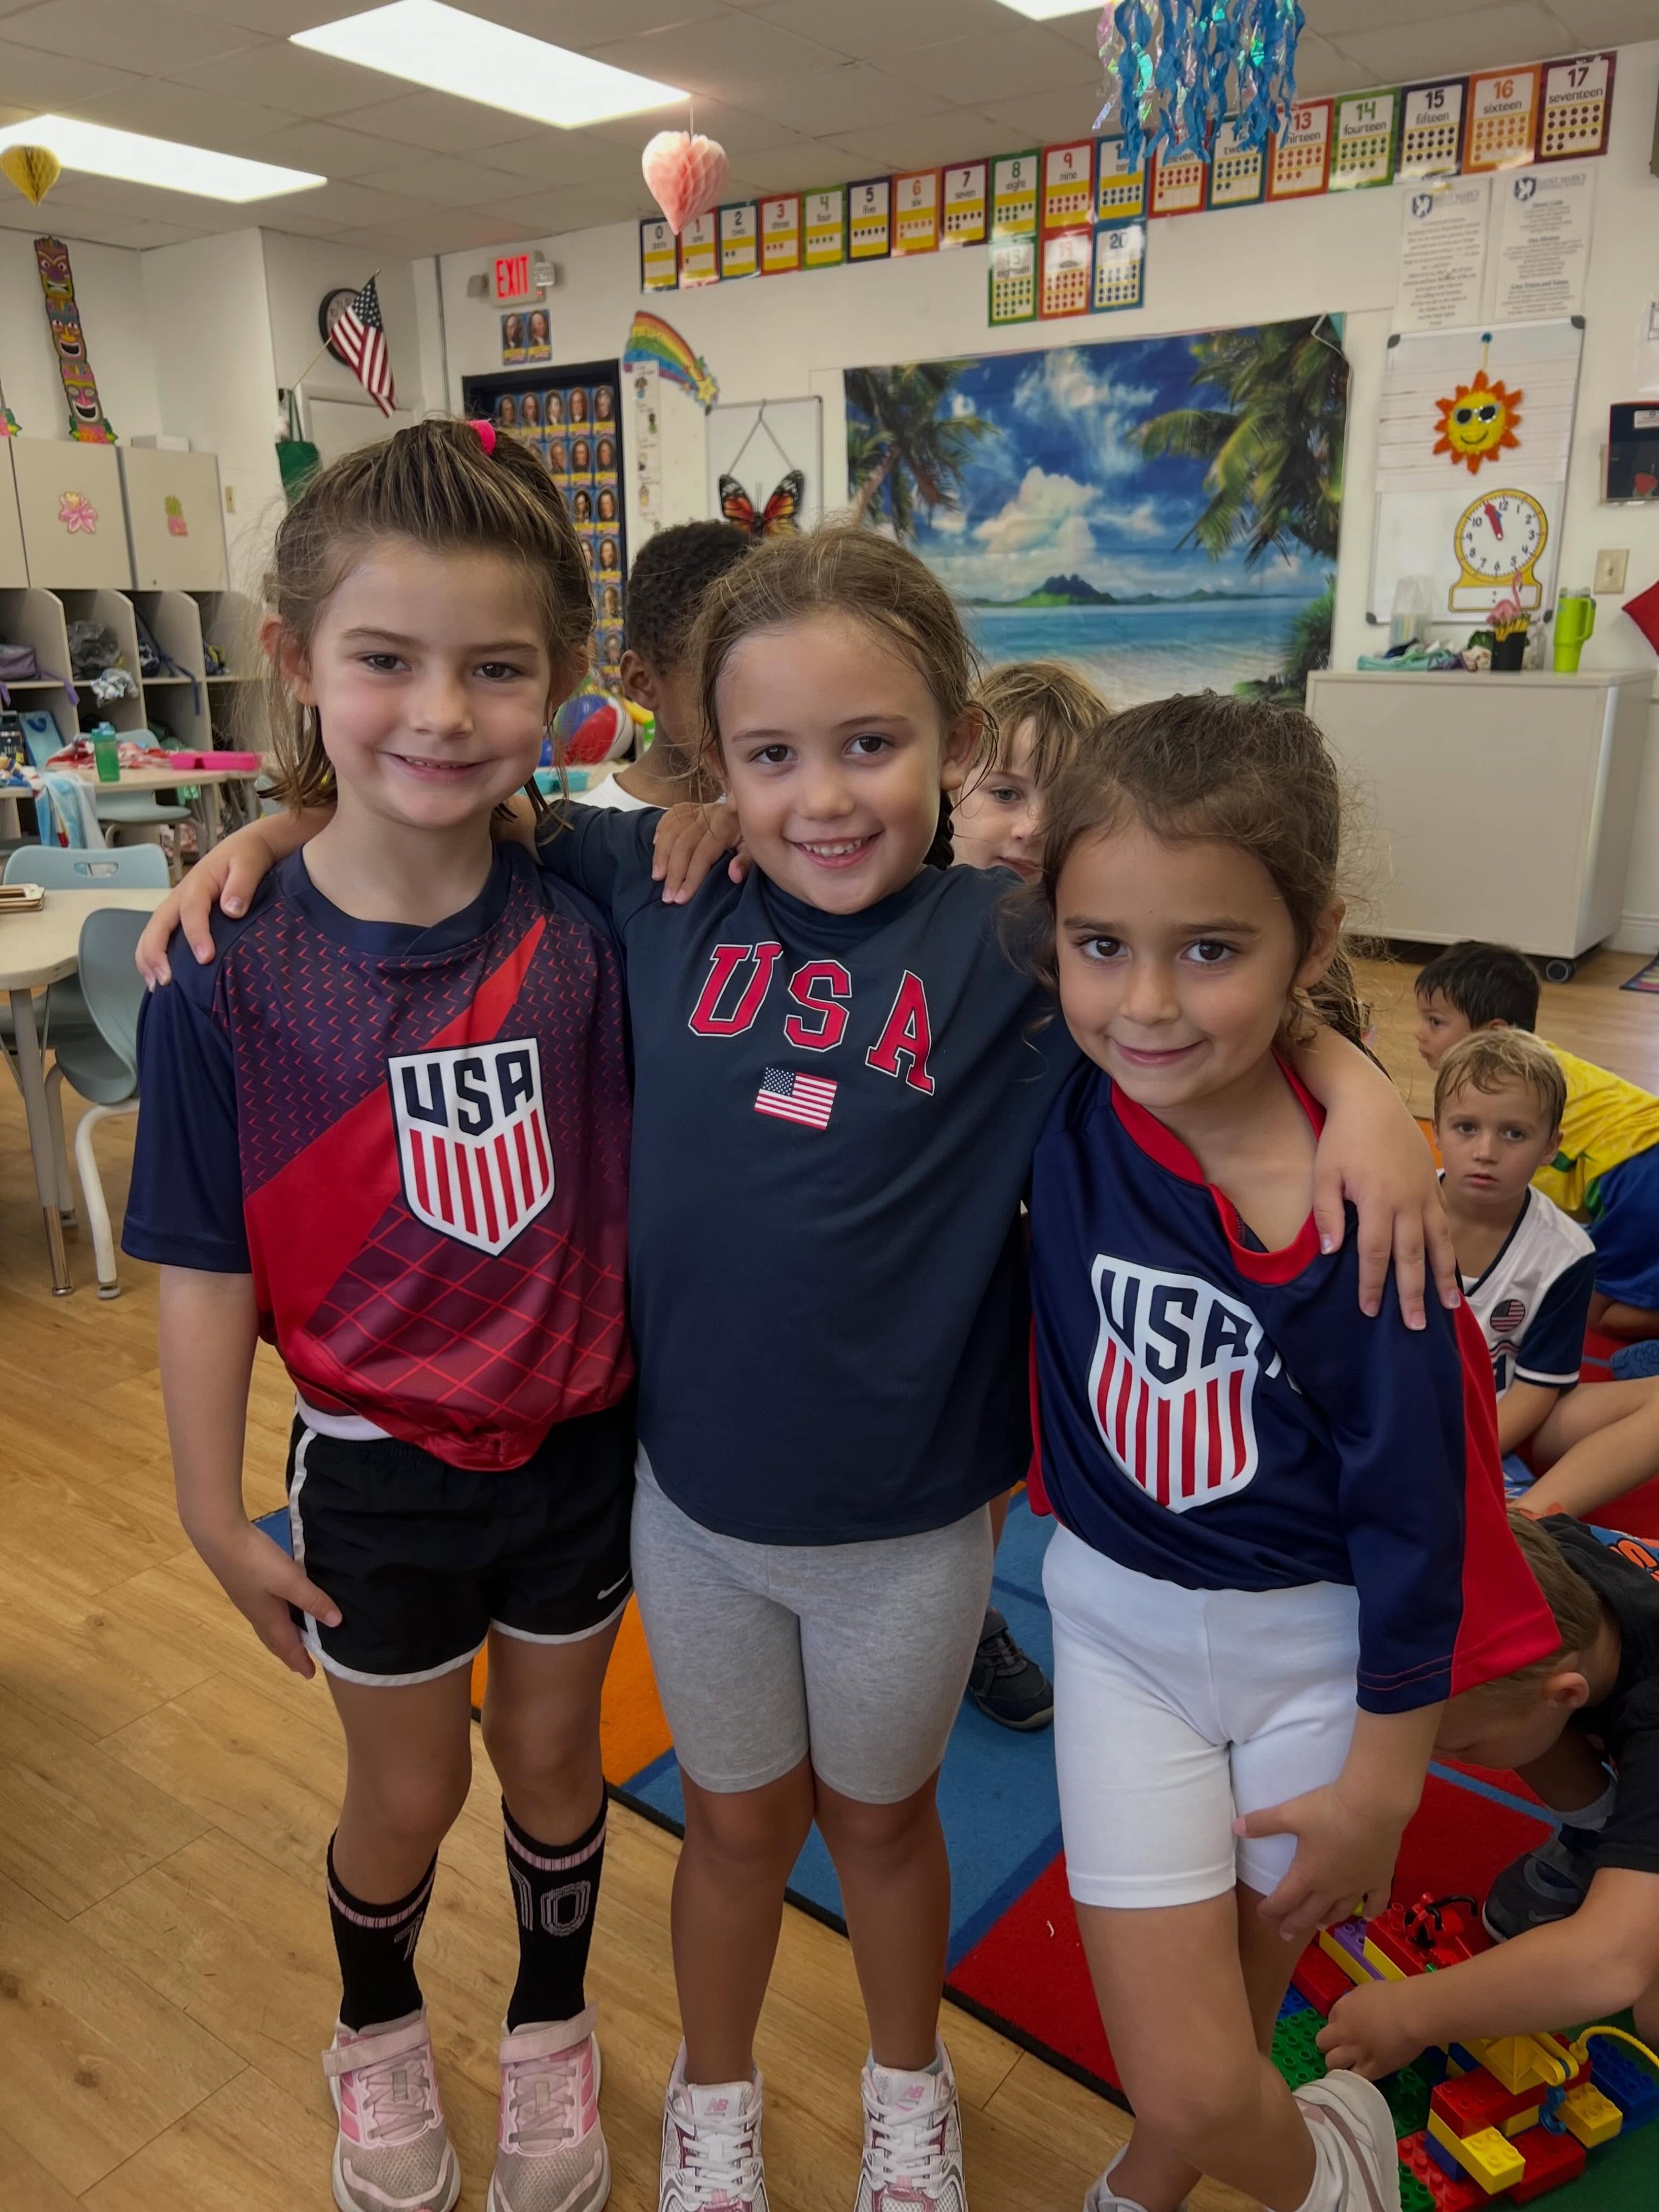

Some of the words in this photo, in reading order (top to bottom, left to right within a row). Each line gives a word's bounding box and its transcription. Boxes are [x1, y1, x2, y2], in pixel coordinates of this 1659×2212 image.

[1568, 66, 1589, 88] 17
[1494, 79, 1514, 99] 16
[1548, 88, 1603, 104] seventeen
[1426, 89, 1445, 109] 15
[1356, 100, 1376, 121] 14
[1483, 100, 1522, 114] sixteen
[1294, 111, 1312, 130] 13
[1415, 111, 1449, 125] fifteen
[1344, 120, 1387, 135] fourteen
[1286, 131, 1321, 144] hirteen
[1064, 152, 1072, 169] 9
[1011, 161, 1021, 179] 8
[963, 170, 971, 188] 7
[865, 186, 874, 202] 5
[912, 179, 921, 196] 6
[776, 203, 785, 218] 3
[820, 195, 830, 211] 4
[695, 218, 701, 232] 1
[735, 210, 743, 226] 2
[655, 226, 663, 240] 0
[495, 255, 529, 299] EXIT
[1498, 500, 1509, 511] 12
[1516, 504, 1520, 514] 1
[1473, 518, 1482, 527] 10
[1526, 514, 1532, 524] 2
[1466, 532, 1473, 542] 9
[1528, 530, 1535, 540] 3
[1469, 547, 1476, 557] 8
[1522, 544, 1528, 554] 4
[1480, 557, 1487, 568] 7
[1494, 561, 1500, 571] 6
[1510, 555, 1517, 566] 5
[688, 941, 935, 1096] USA
[401, 1049, 534, 1137] USA
[1100, 1268, 1253, 1385] USA
